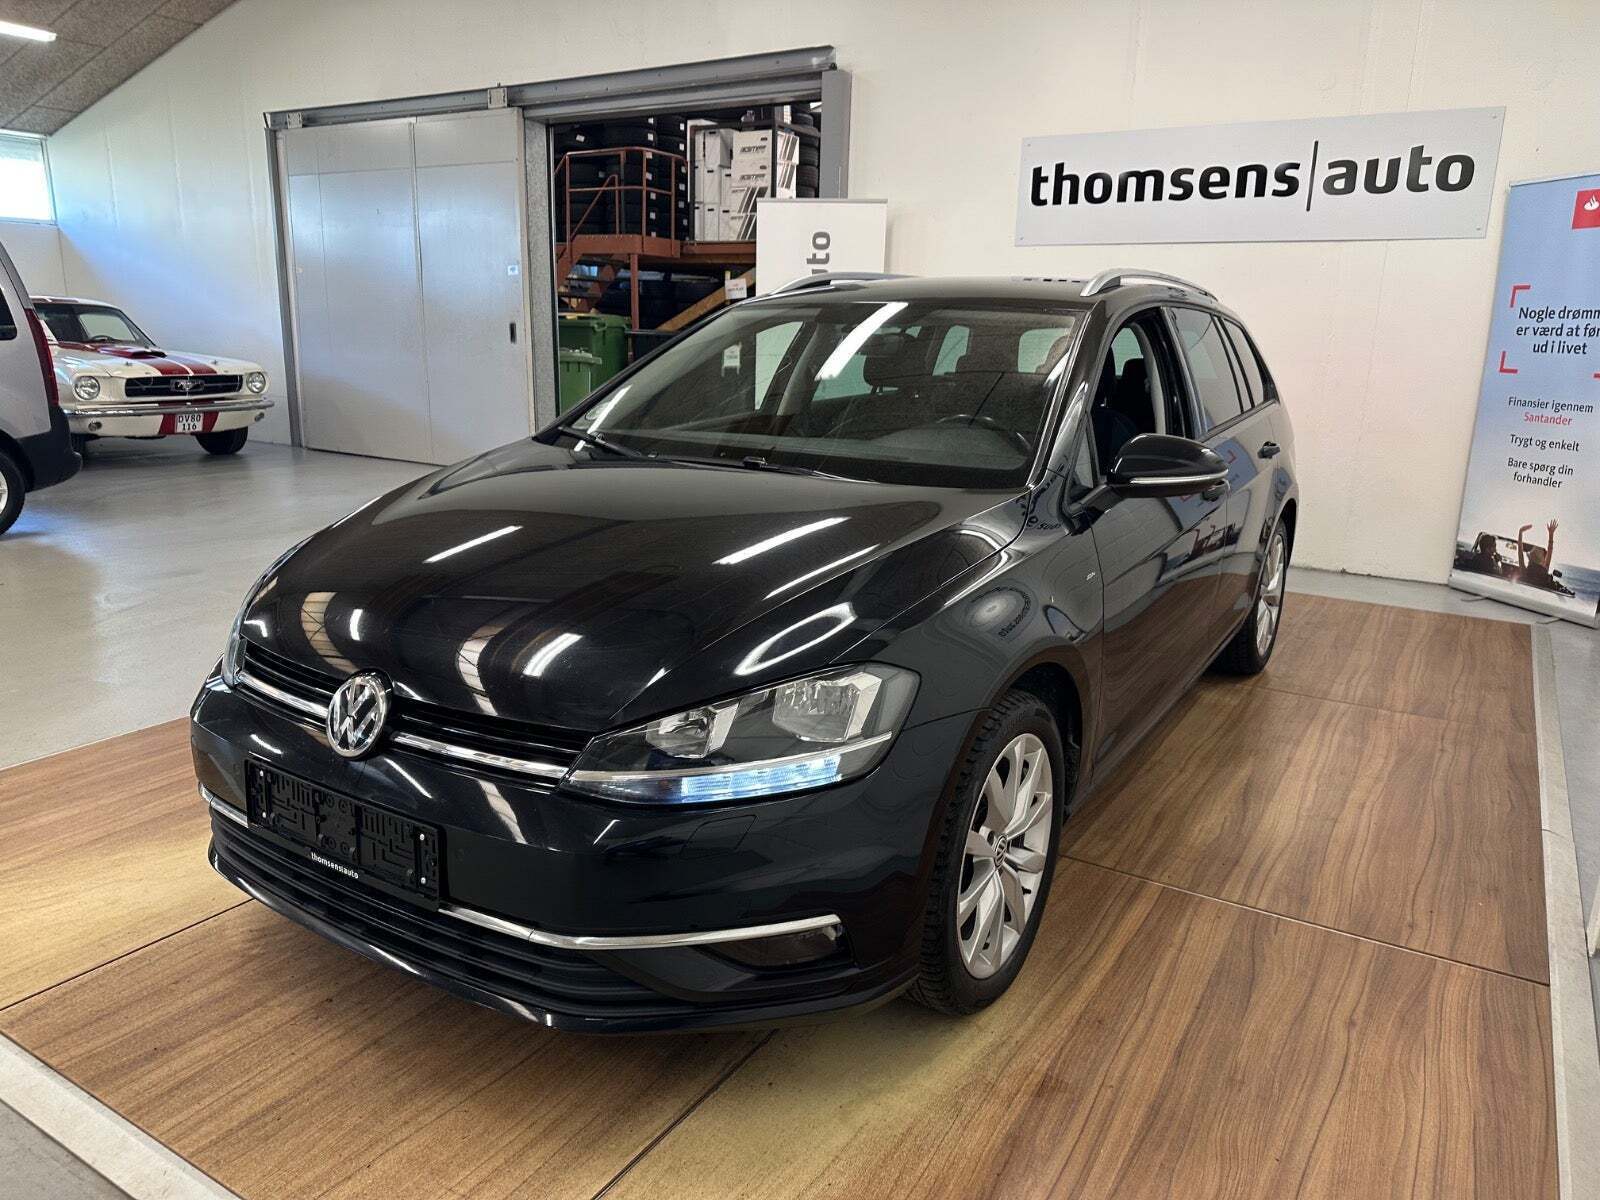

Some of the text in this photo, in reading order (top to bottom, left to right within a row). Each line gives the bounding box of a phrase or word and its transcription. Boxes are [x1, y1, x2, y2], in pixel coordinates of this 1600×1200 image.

[1519, 306, 1555, 323] Nogle
[1516, 326, 1529, 336] er
[1533, 323, 1563, 337] værd
[1566, 325, 1580, 337] at
[1533, 339, 1587, 354] ud i livet
[1508, 396, 1594, 413] Finansier igennem
[1523, 411, 1573, 426] Santander
[182, 423, 197, 431] 116
[1510, 434, 1580, 452] Trygt og enkelt
[1508, 457, 1574, 476] Bare spørg din
[1513, 472, 1563, 488] forhandler
